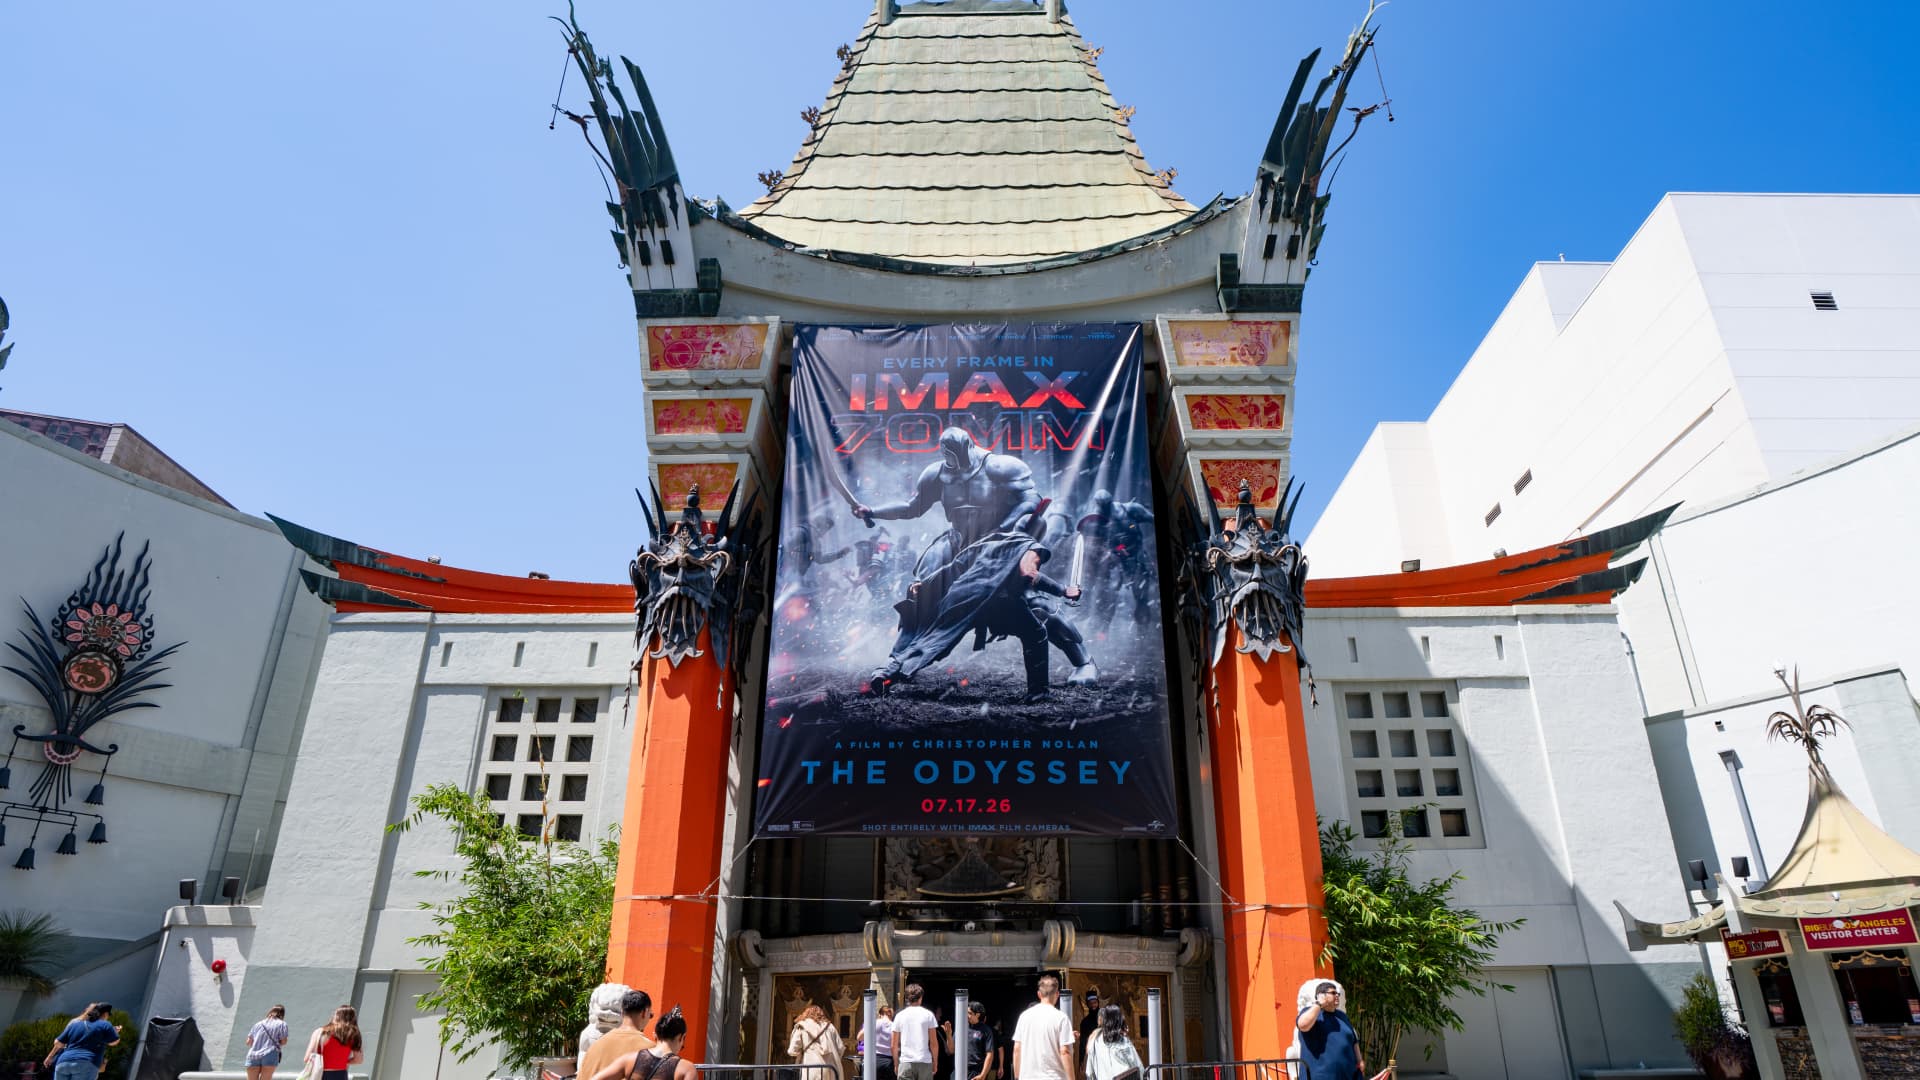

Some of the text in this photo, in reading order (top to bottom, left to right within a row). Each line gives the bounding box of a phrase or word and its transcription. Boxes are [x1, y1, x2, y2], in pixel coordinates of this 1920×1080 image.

[883, 355, 1054, 369] EVERY FRAME IN
[849, 371, 1086, 411] IMAX
[835, 740, 1099, 749] A FILM BY CHRISTOPHER NOLAN
[801, 759, 1132, 785] THE ODYSSEY
[920, 798, 1011, 813] 07.17.26
[862, 824, 1071, 832] SHOT ENTIRELY WITH IMAX FILM CAMERAS
[1859, 917, 1907, 929] ANGELES
[1810, 927, 1899, 940] VISITOR CENTER
